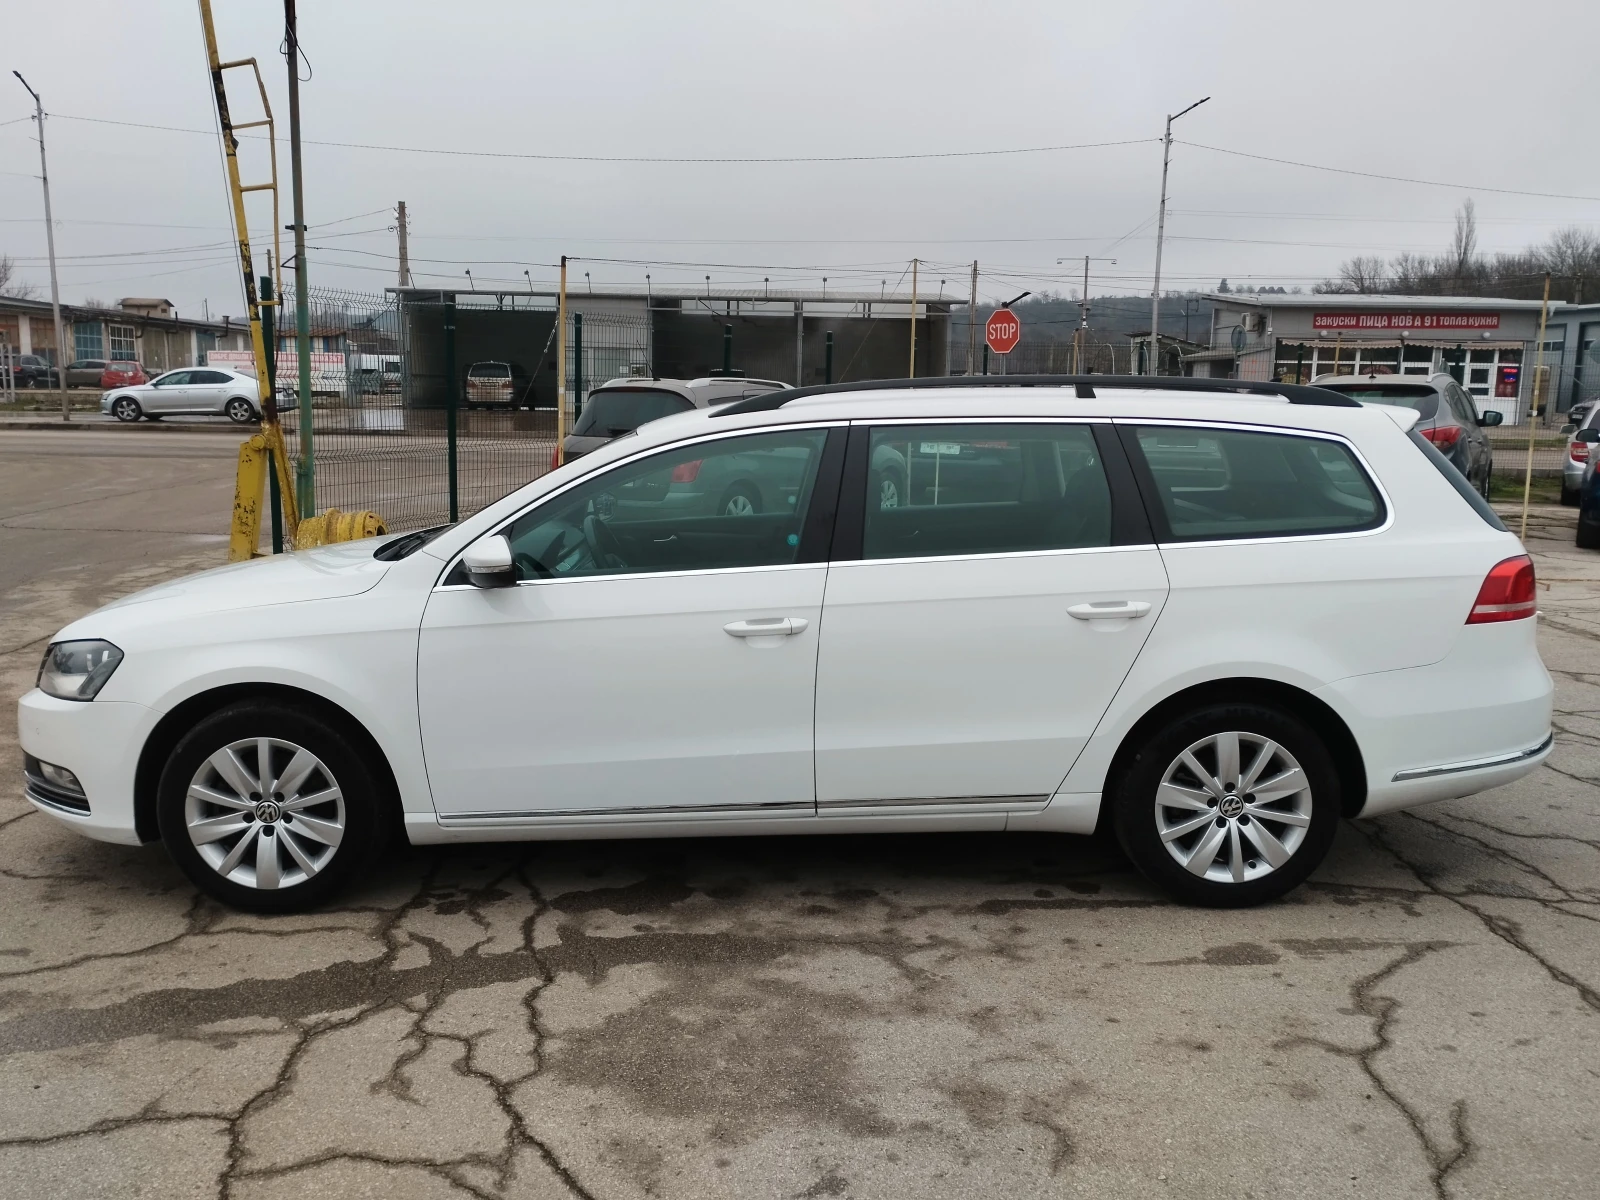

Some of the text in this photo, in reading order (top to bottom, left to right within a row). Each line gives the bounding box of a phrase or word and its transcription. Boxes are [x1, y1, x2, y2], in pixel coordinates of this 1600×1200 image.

[1315, 316, 1356, 327] закуски
[1359, 316, 1388, 328] ПИЦА
[1424, 316, 1437, 327] 91
[1439, 316, 1468, 326] топла
[1468, 316, 1498, 327] кухня
[989, 323, 1016, 339] STOP
